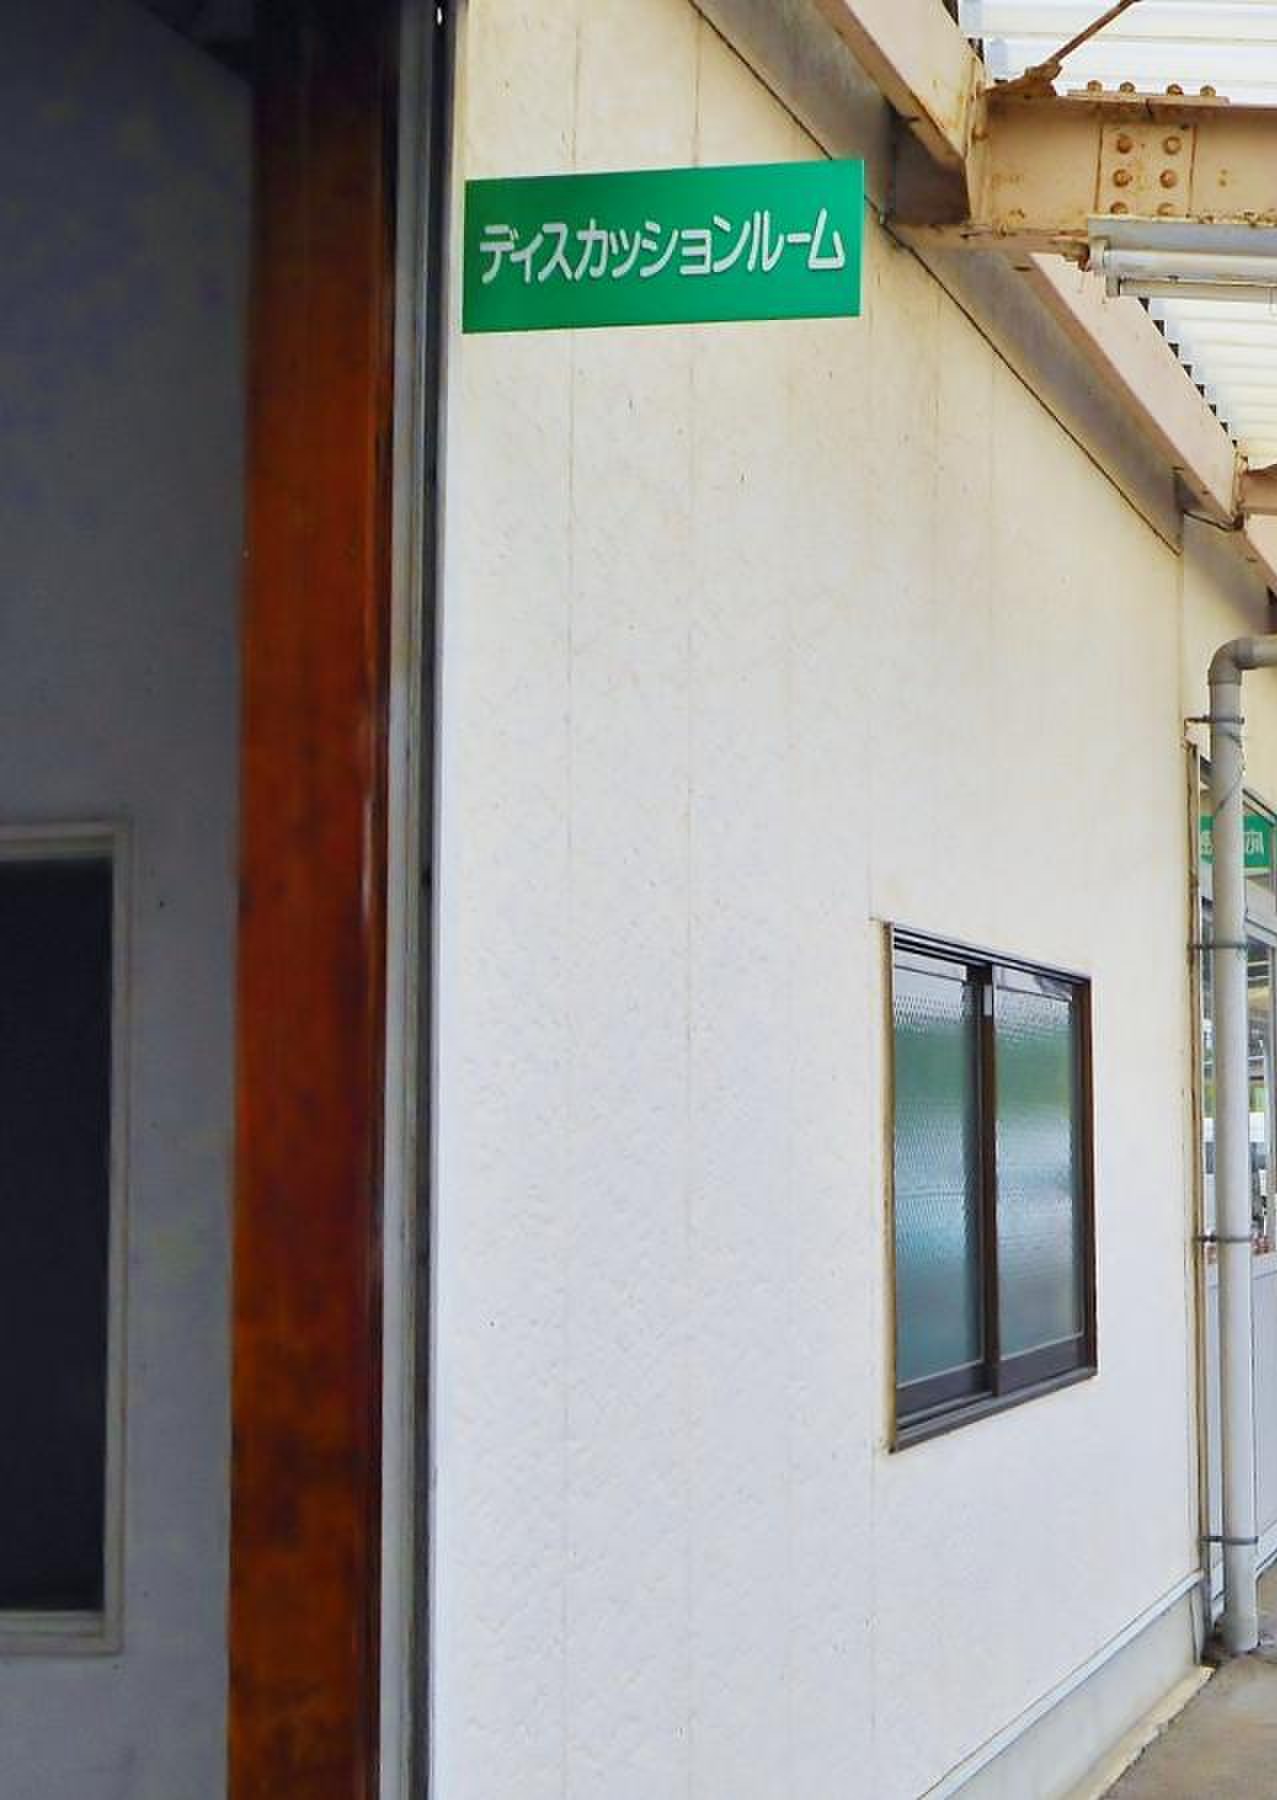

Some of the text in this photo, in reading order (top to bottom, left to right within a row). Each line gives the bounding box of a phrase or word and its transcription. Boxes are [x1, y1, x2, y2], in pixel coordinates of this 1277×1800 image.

[479, 207, 846, 285] ディスカッションルーム
